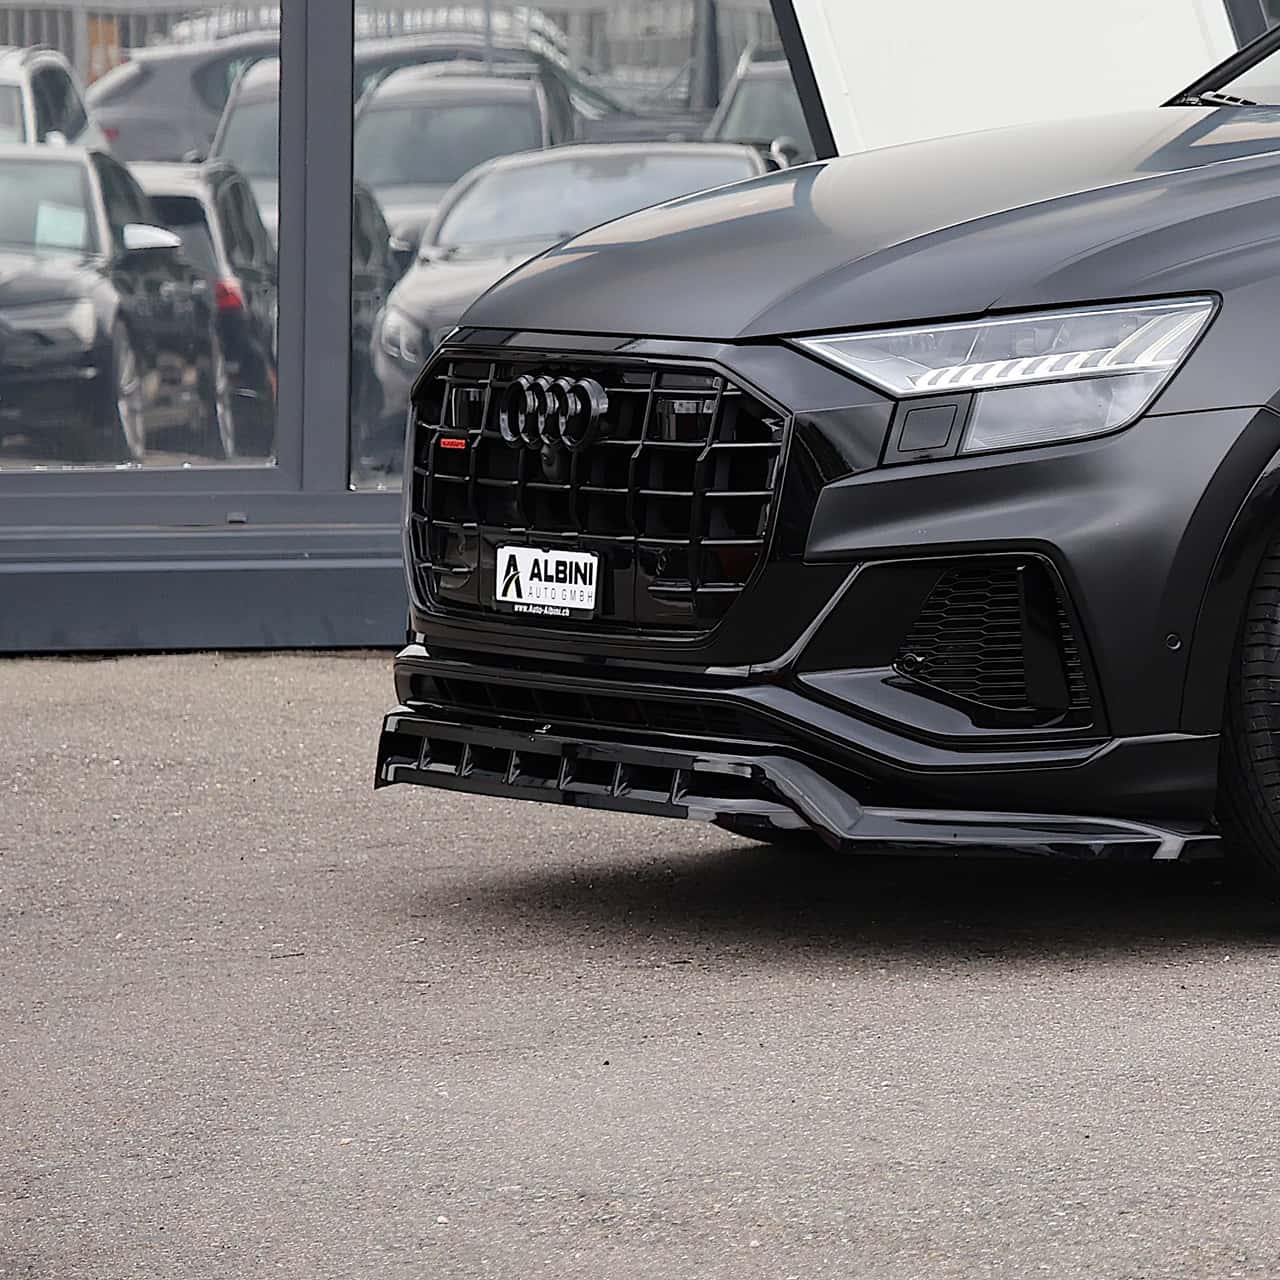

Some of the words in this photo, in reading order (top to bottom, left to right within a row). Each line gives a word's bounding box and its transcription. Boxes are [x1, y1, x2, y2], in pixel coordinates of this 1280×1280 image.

[529, 558, 593, 585] ALBINI
[528, 586, 556, 600] AUTO
[561, 588, 593, 603] GMBH
